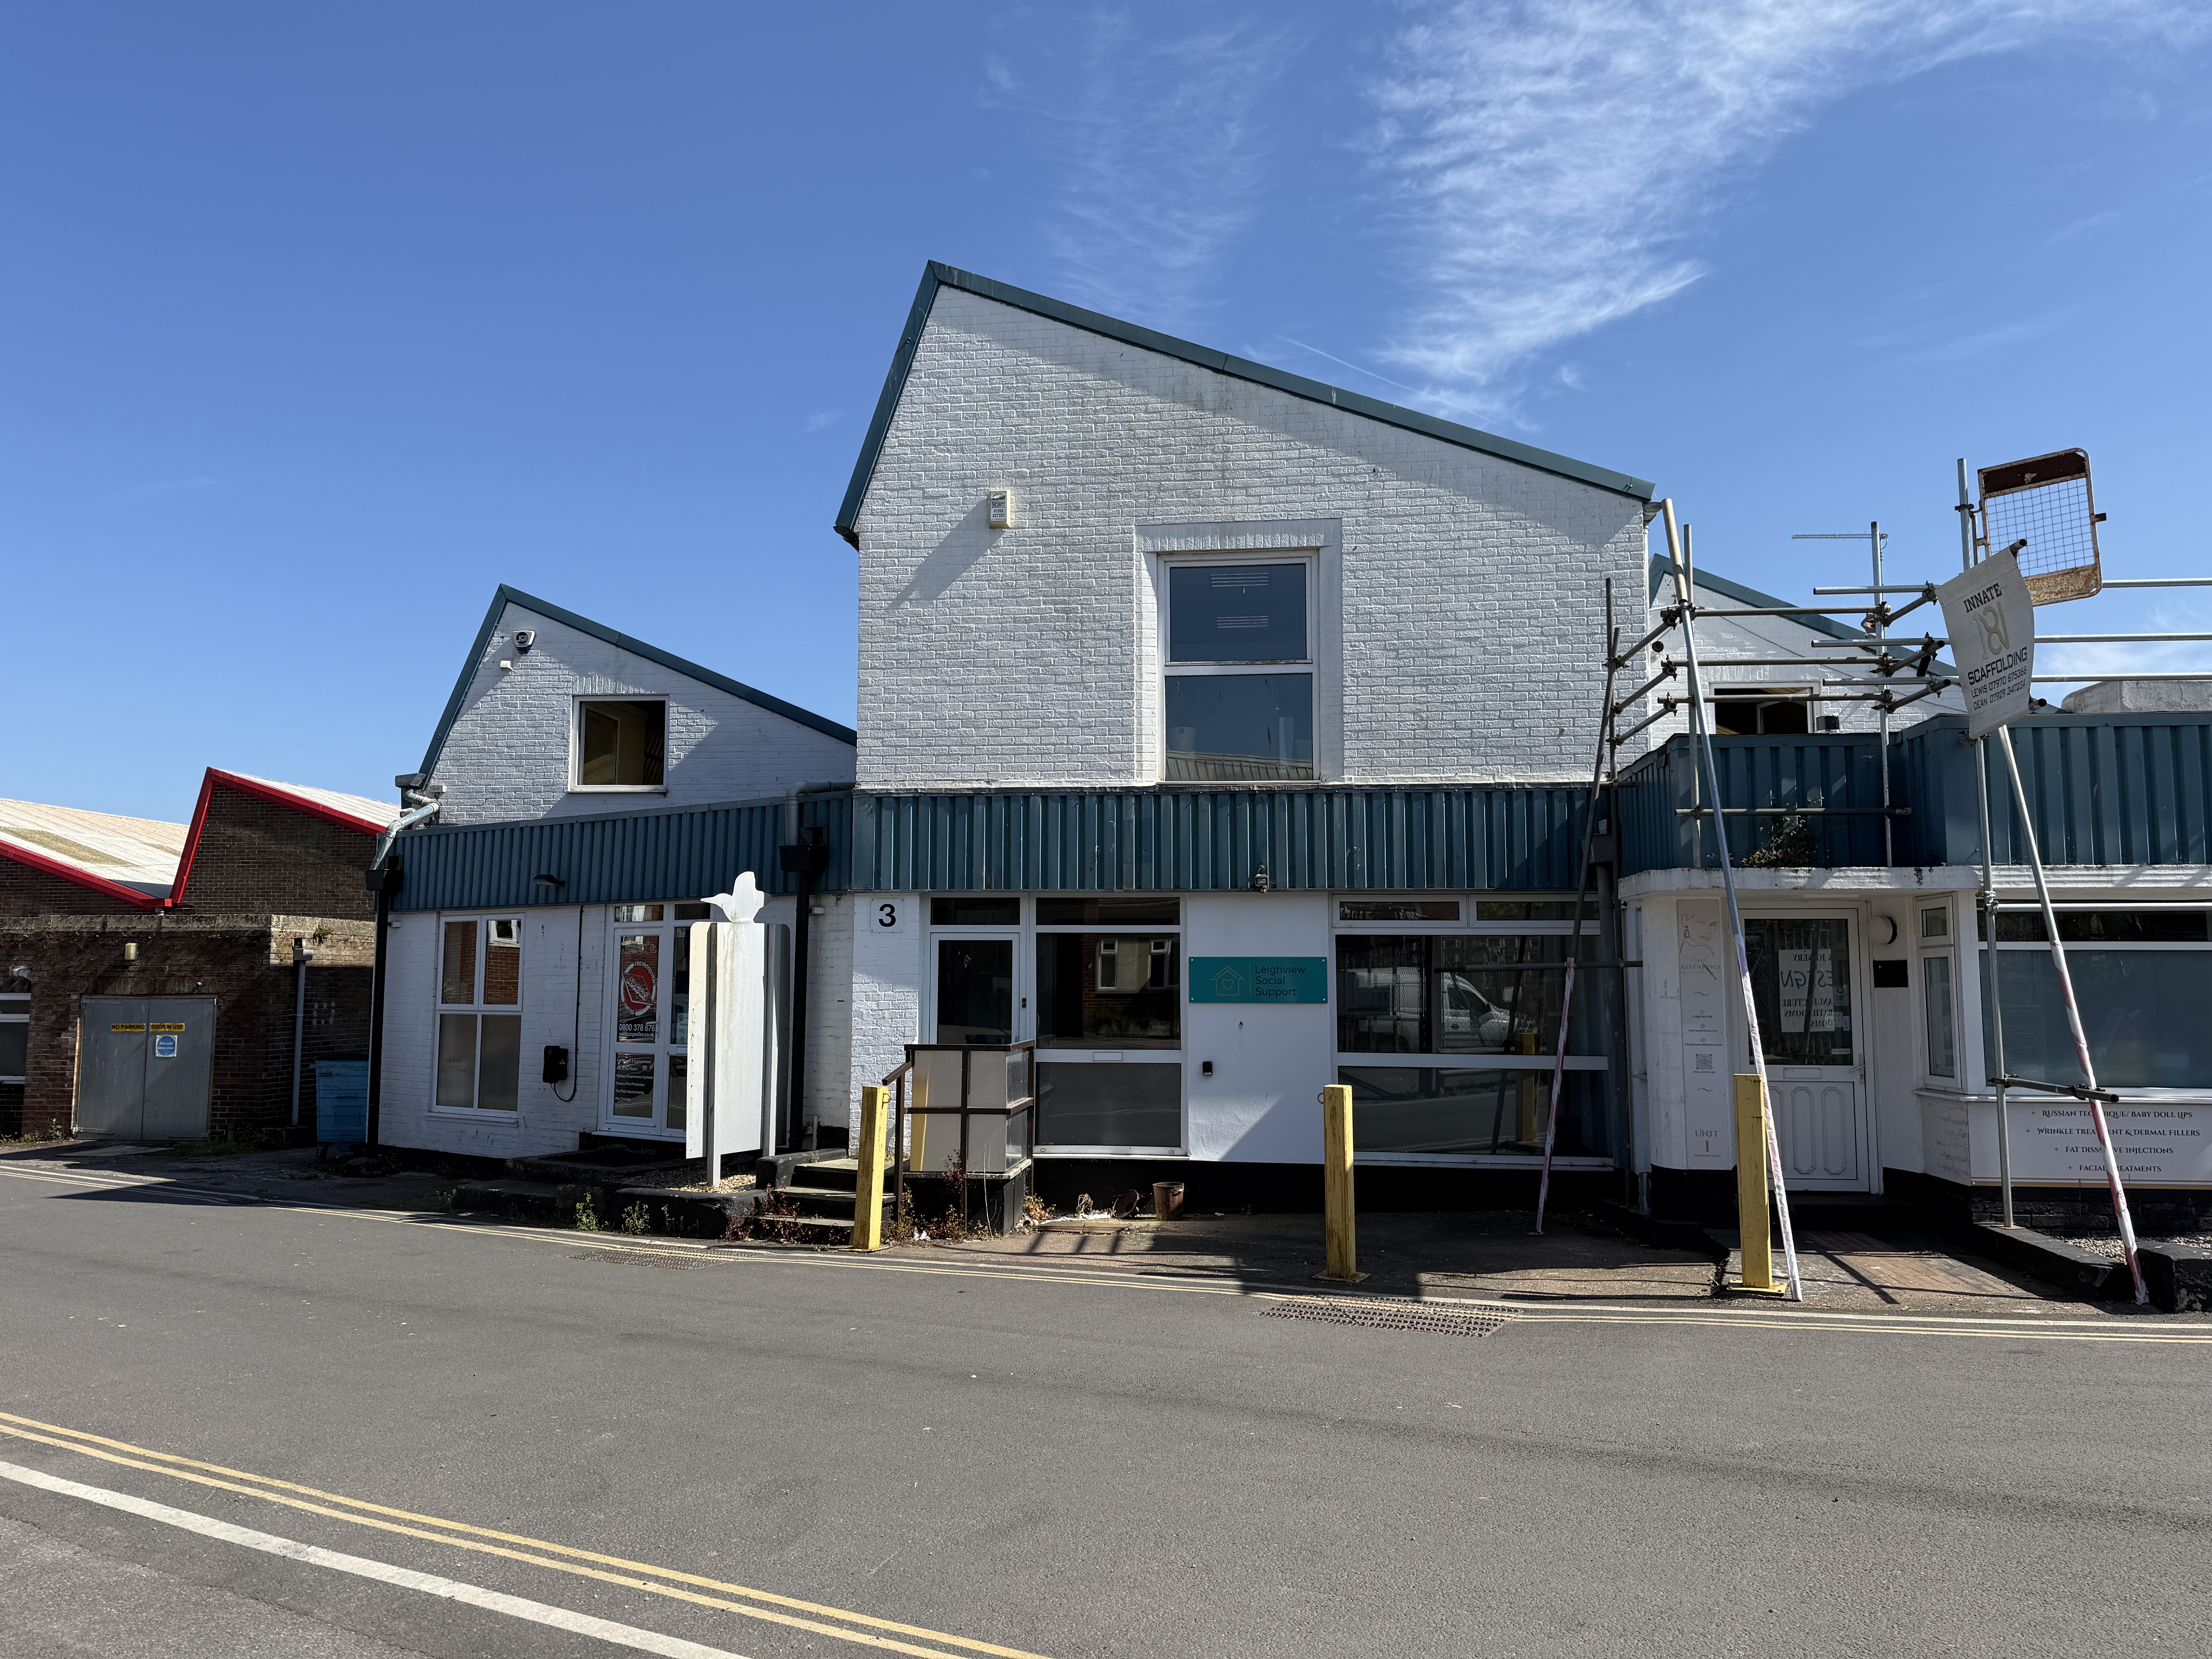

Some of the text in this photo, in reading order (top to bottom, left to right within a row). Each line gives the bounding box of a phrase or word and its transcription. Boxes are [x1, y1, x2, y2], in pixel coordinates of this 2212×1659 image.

[1963, 582, 2002, 613] INNATE
[1968, 646, 2027, 685] SCAFFOLDING
[1971, 665, 2027, 698] LEWIS 07970 675366
[1973, 678, 2025, 710] DEAN 07929 347234
[878, 903, 896, 927] 3
[642, 962, 657, 984] PROTECTION
[1255, 965, 1305, 976] Leighview
[1255, 976, 1285, 984] Social
[626, 977, 649, 1001] ARGOS
[1255, 988, 1297, 998] Support
[623, 1002, 635, 1015] LIMITED
[2077, 1110, 2129, 1118] TECIQUE/
[1695, 1129, 1719, 1138] UNIT
[2037, 1127, 2074, 1135] WRINKLE
[1705, 1140, 1709, 1152] 1
